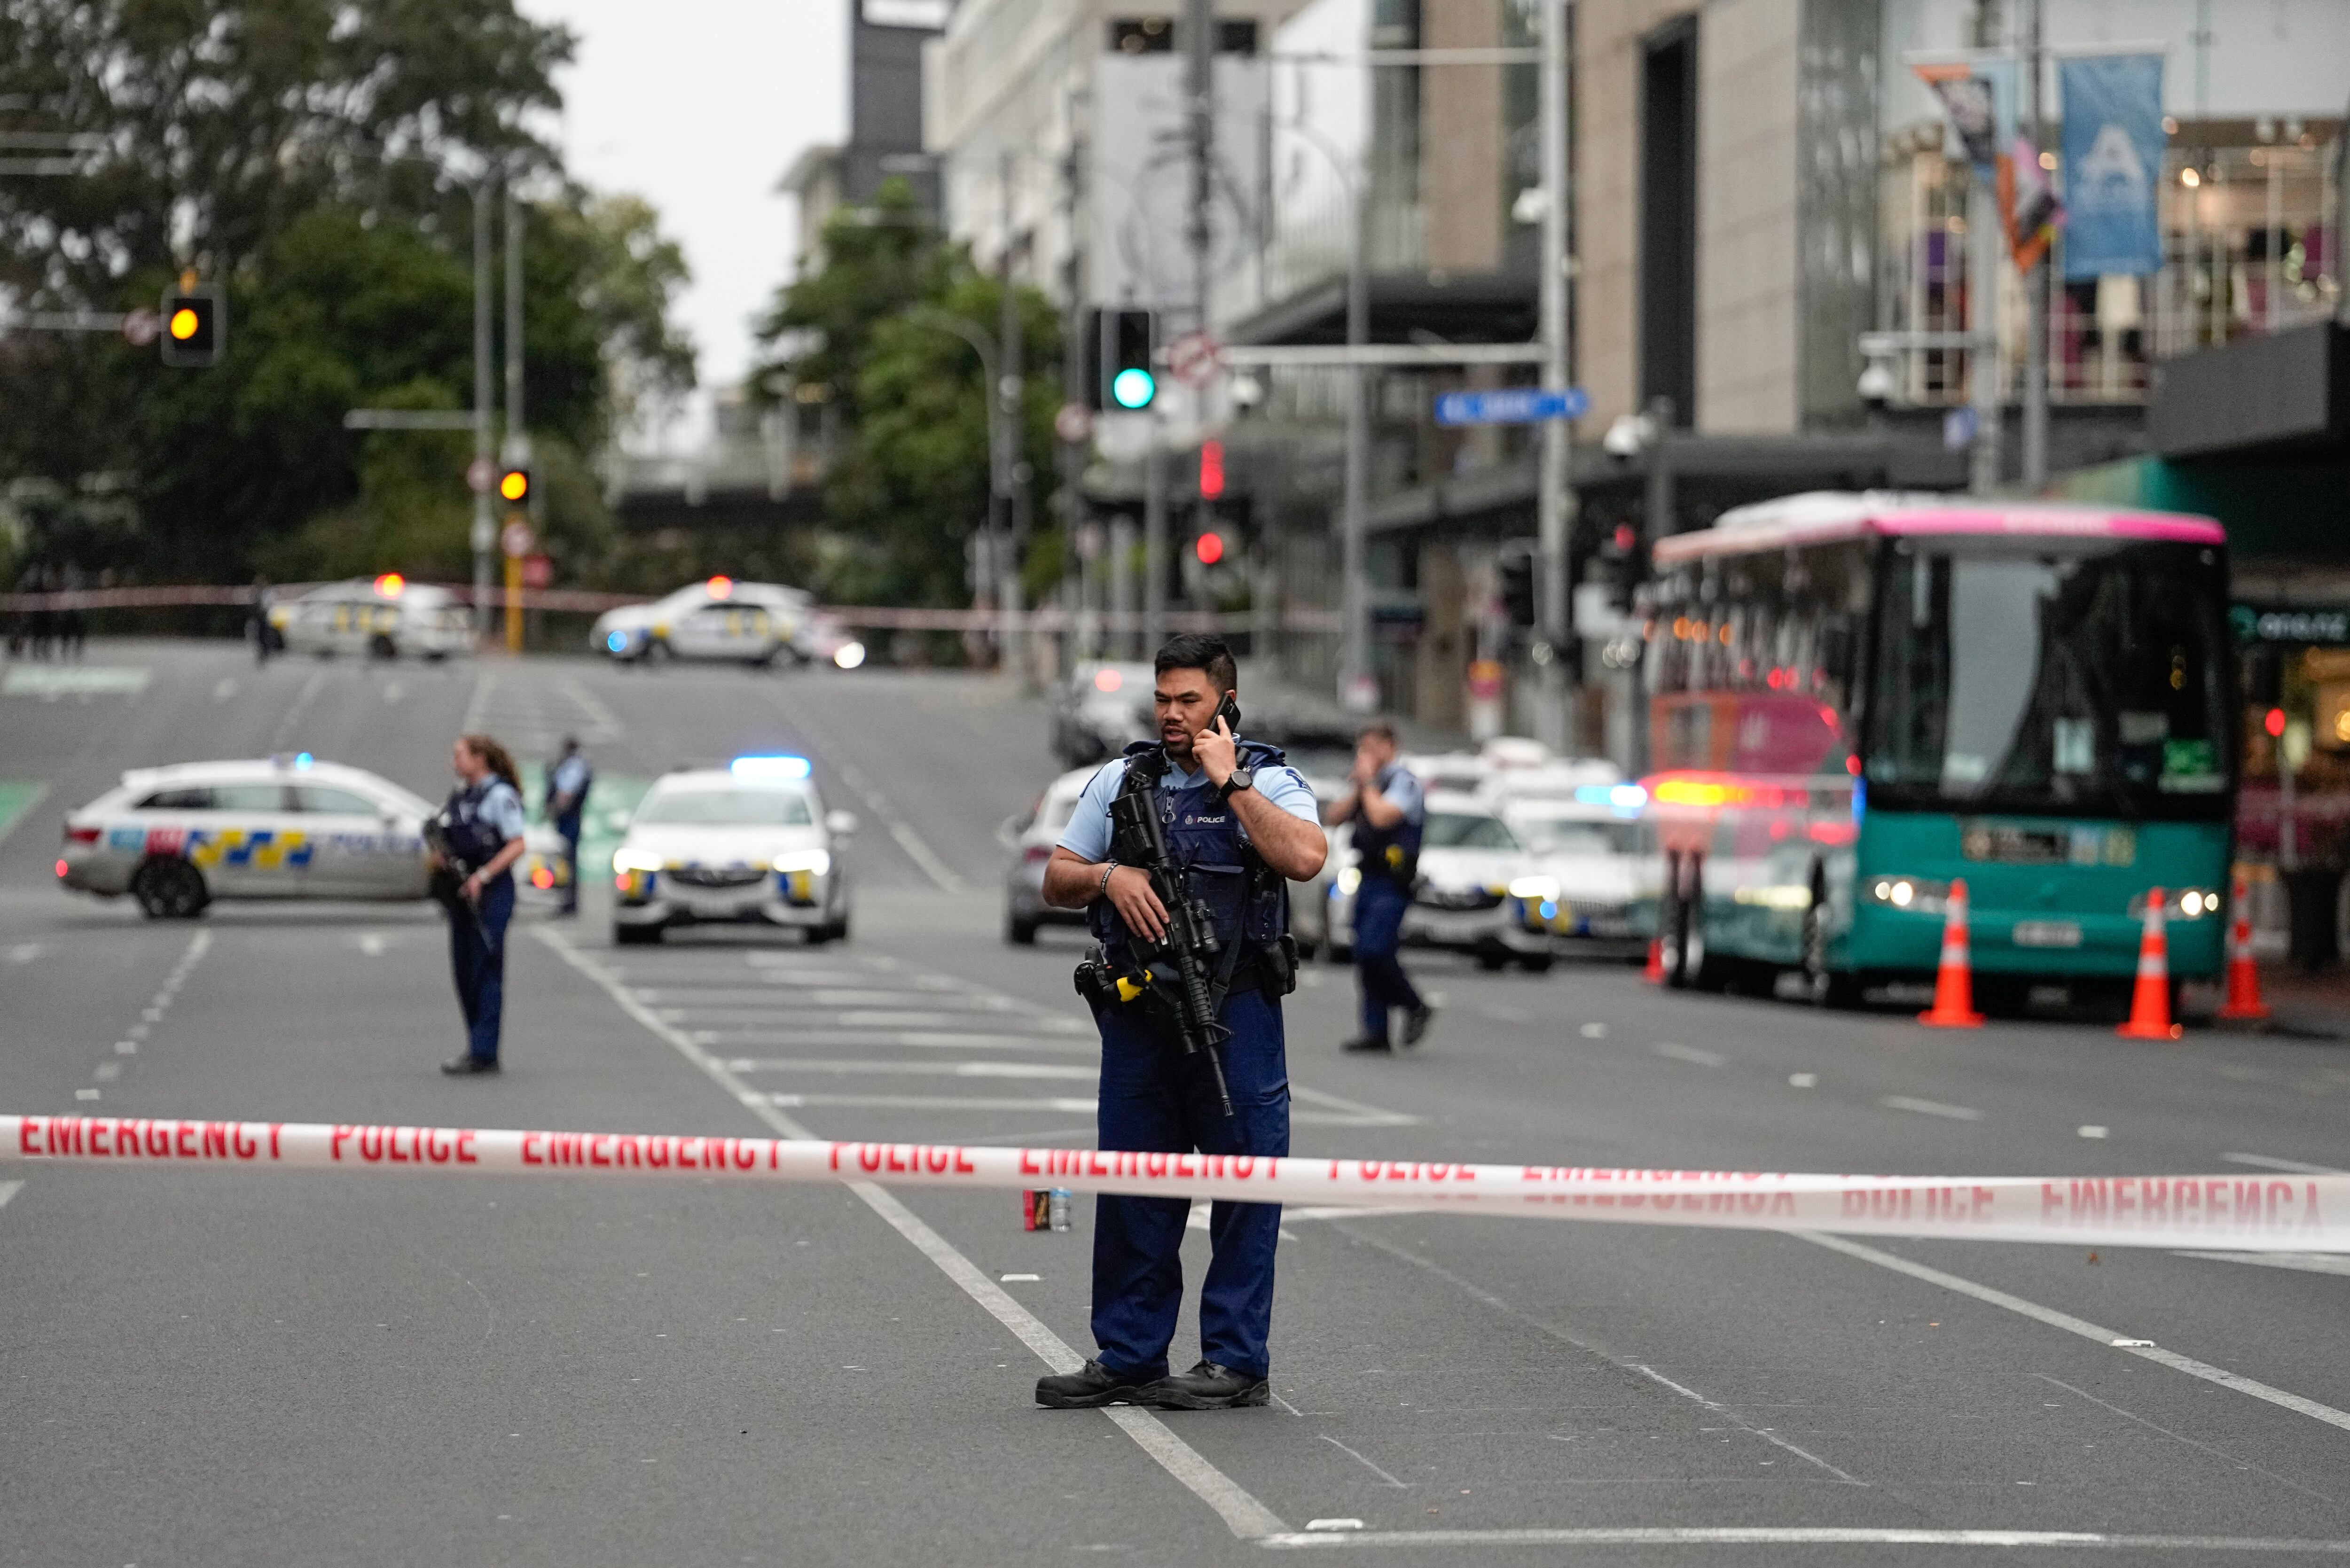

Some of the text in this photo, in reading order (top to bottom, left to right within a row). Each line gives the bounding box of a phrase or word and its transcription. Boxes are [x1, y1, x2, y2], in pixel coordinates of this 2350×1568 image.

[1103, 868, 1112, 882] PLEDGE
[19, 1117, 283, 1161] EMERGENCY
[331, 1124, 478, 1164] POLICE
